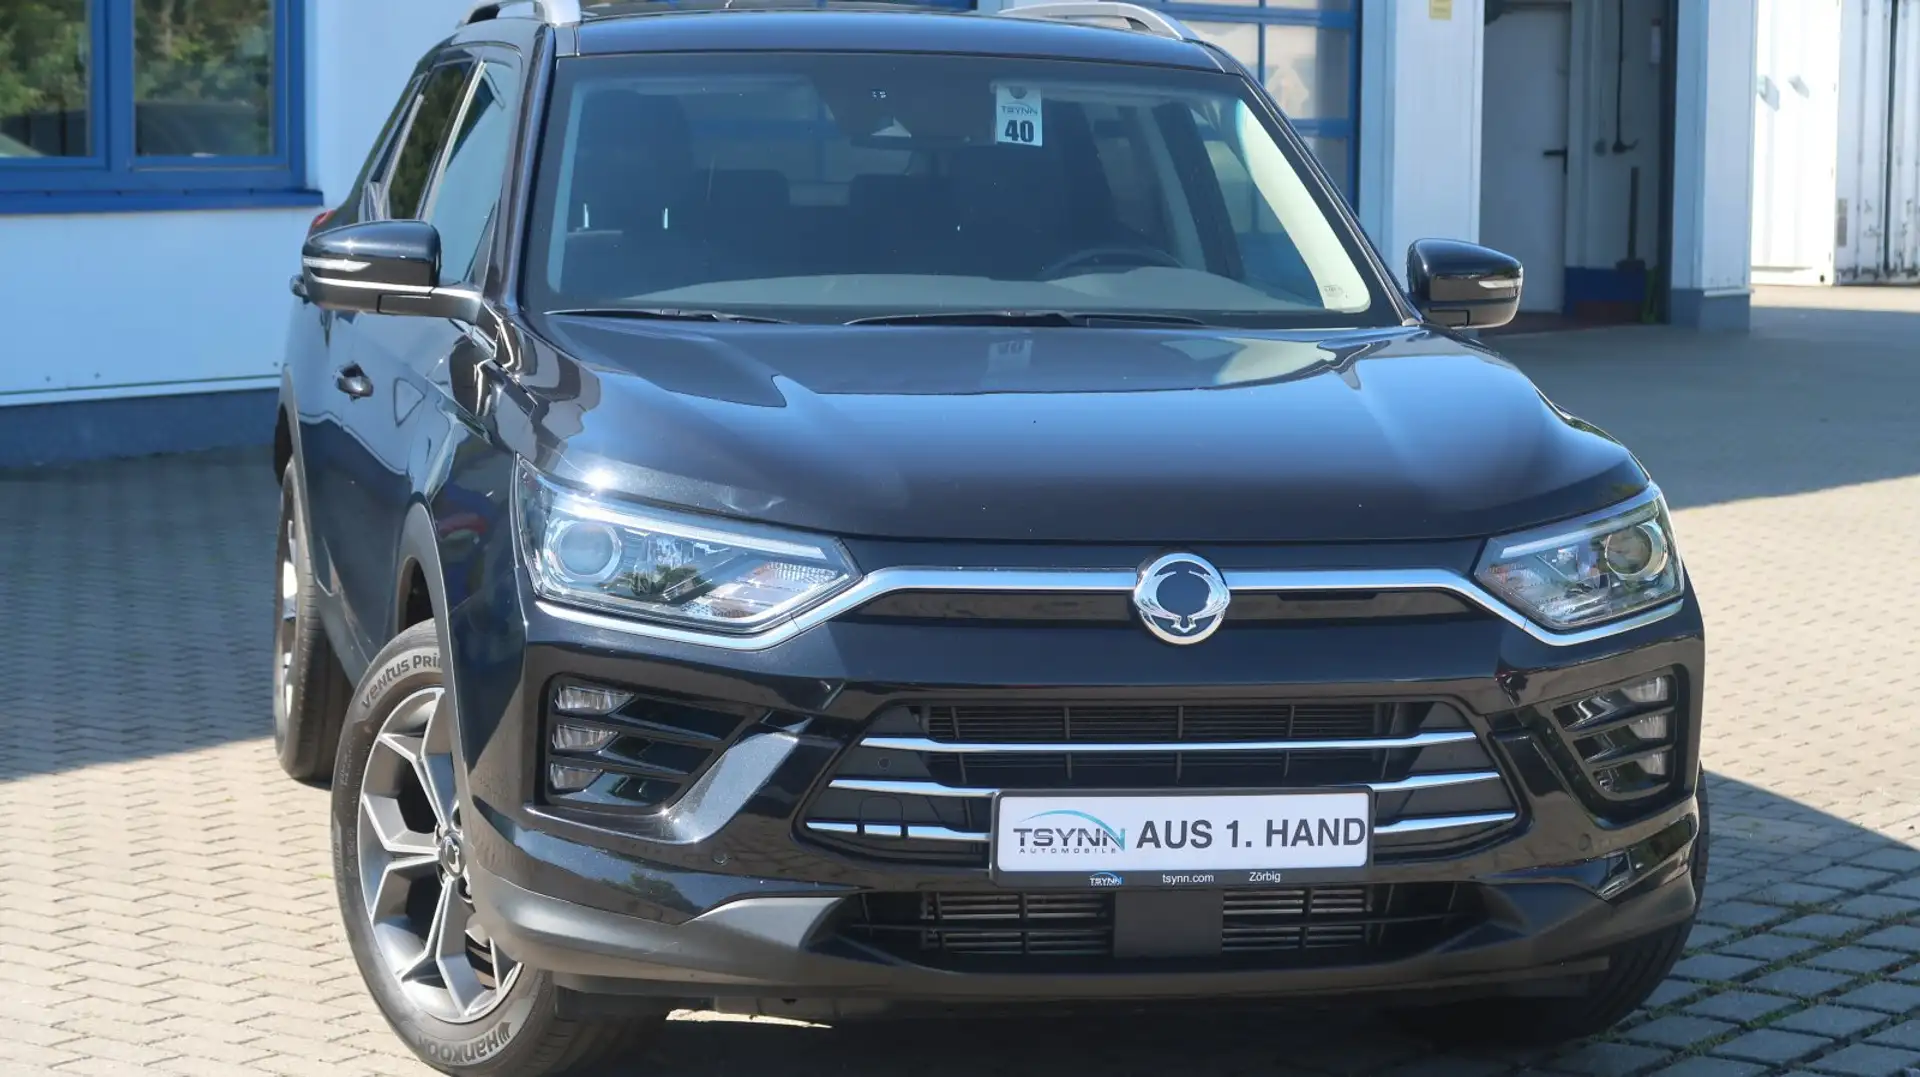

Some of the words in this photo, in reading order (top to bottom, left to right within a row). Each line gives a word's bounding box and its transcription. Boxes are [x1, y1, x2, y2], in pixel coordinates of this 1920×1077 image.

[1005, 119, 1034, 142] 40
[1013, 827, 1126, 851] TSYNN
[1136, 819, 1212, 849] AUS
[1226, 820, 1252, 848] 1.
[1266, 817, 1366, 847] HAND
[1162, 873, 1215, 886] tsynn.com
[1249, 871, 1281, 884] Zörbig
